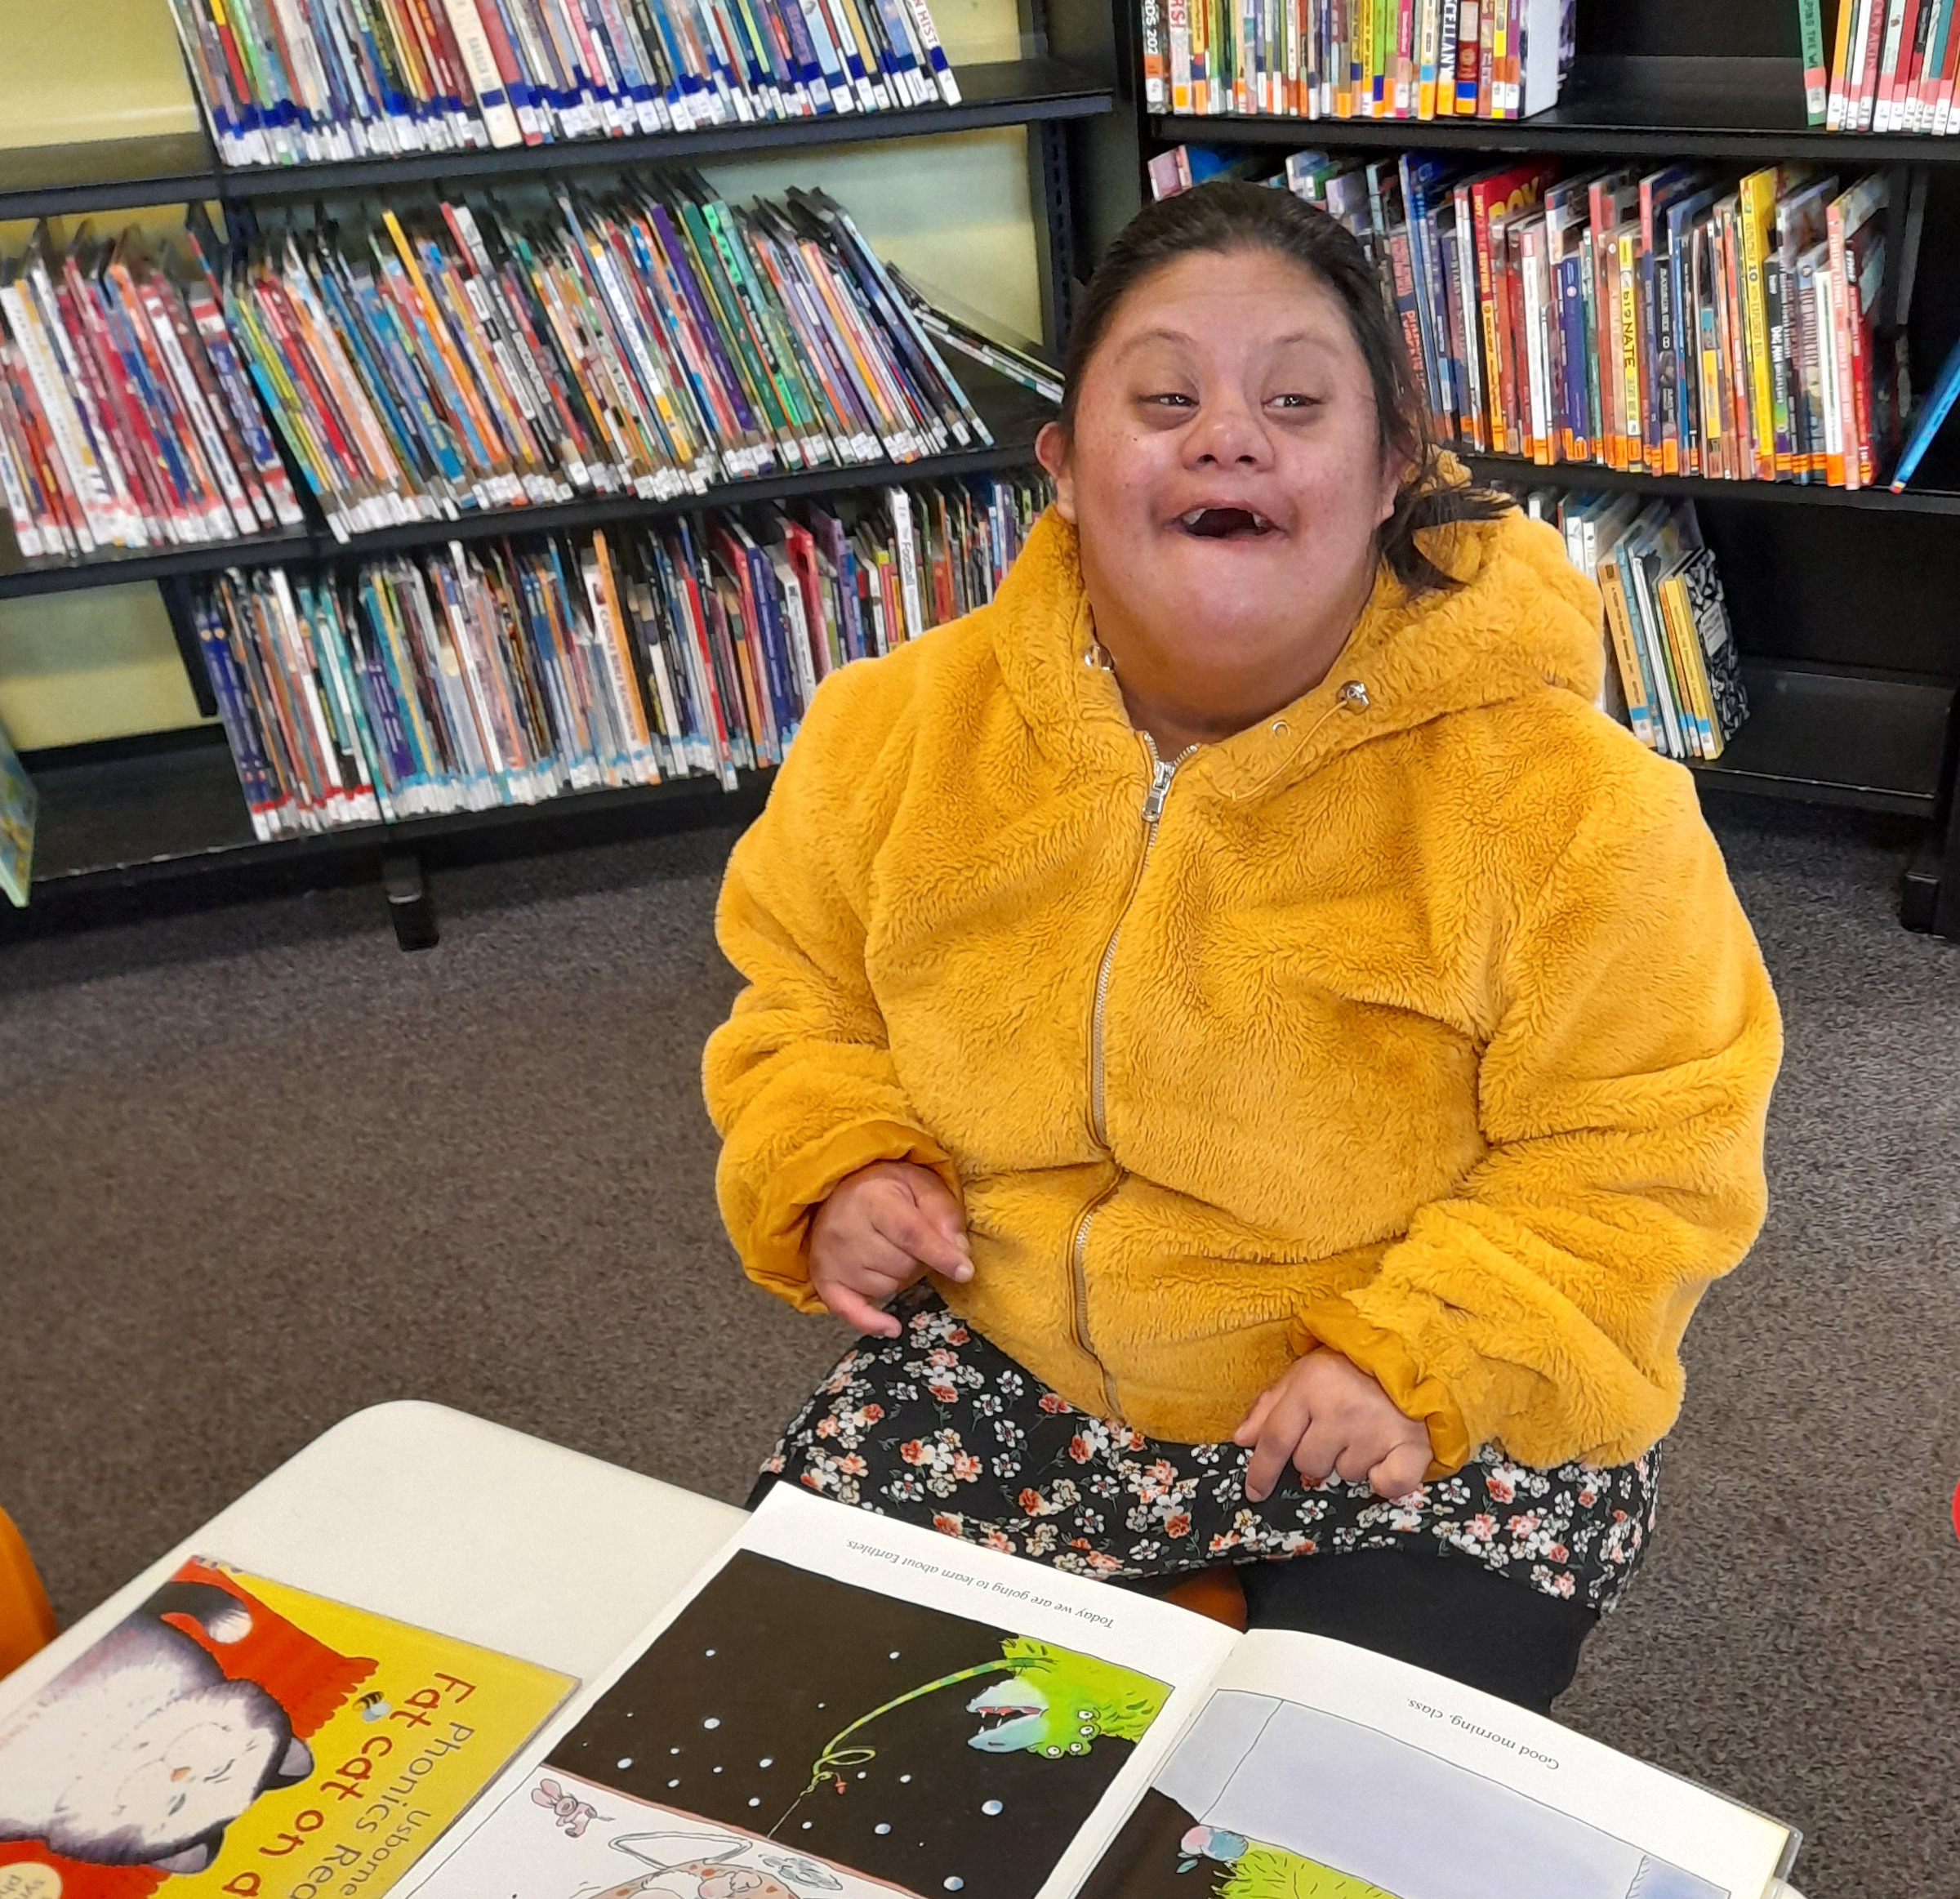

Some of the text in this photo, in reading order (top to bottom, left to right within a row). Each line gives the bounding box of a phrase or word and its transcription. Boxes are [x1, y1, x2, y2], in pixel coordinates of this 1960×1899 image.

[1748, 265, 1759, 282] 10
[1623, 322, 1635, 368] NATE
[846, 1539, 1115, 1629] Today we are going to learn about Earthlets.
[355, 1722, 475, 1834] Phonics
[1406, 1698, 1560, 1770] Good morning, class.
[221, 1672, 476, 1897] Fat cat on a
[339, 1808, 432, 1896] Usborne
